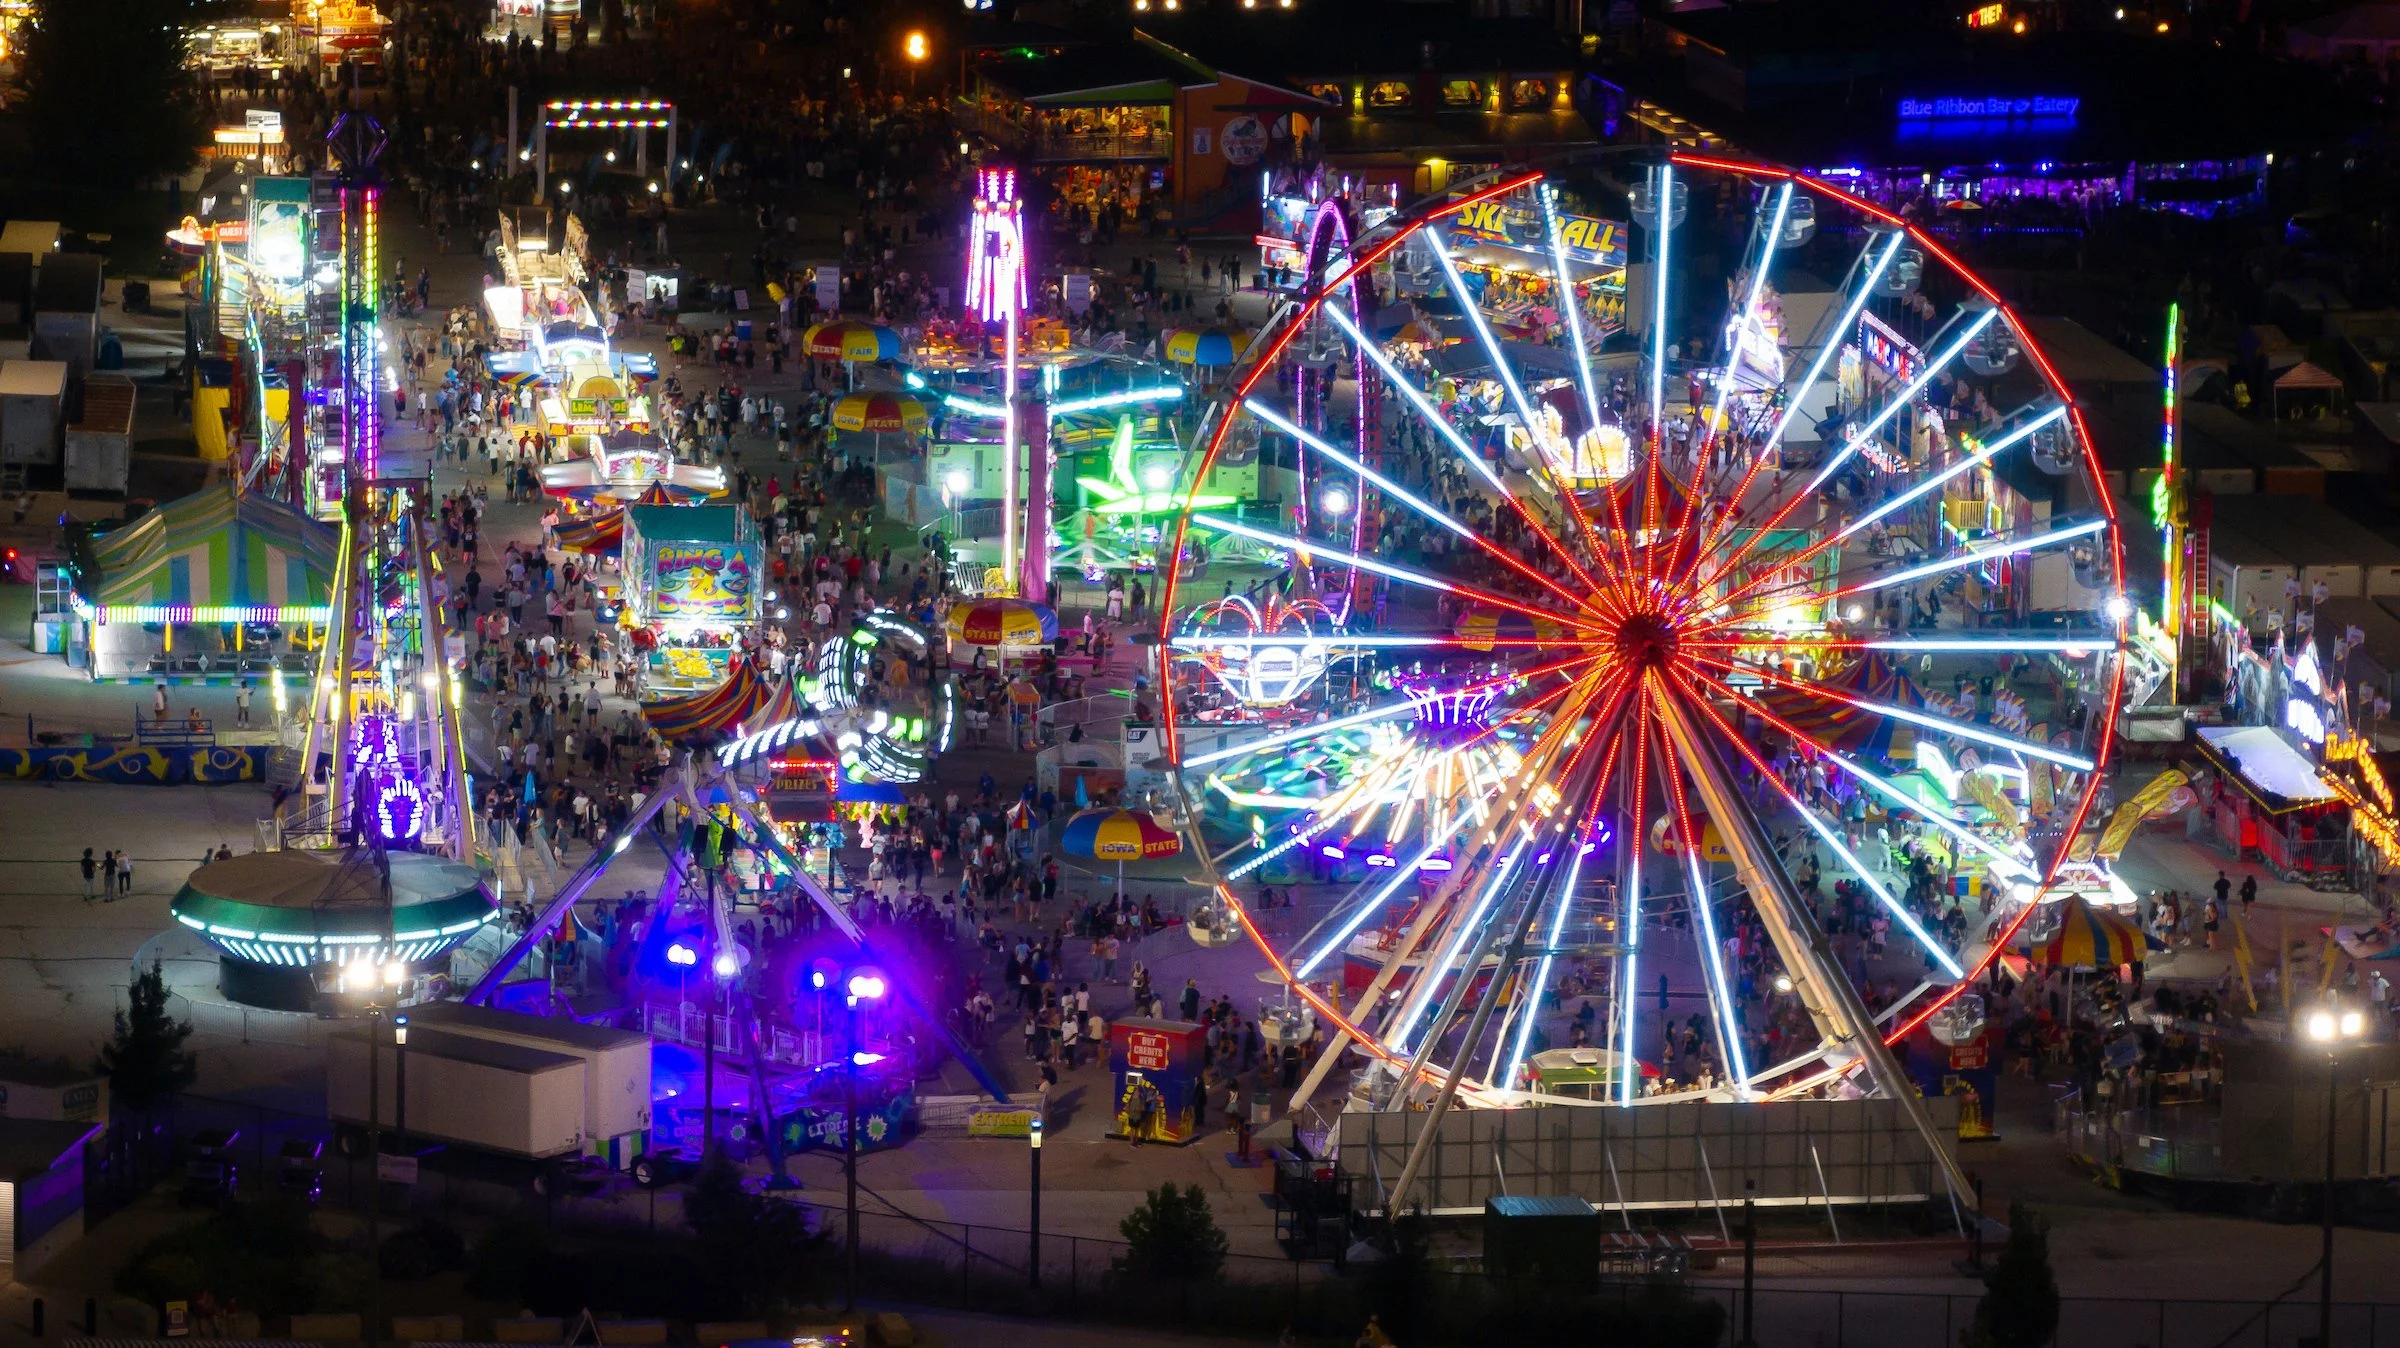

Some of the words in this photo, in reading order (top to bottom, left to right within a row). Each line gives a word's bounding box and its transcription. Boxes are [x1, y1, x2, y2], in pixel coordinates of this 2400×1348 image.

[1902, 99, 1932, 116] Blue
[1936, 97, 1985, 115] Ribbon
[1987, 97, 2012, 113] Bar
[2014, 98, 2031, 113] &
[2034, 95, 2079, 115] Eatery
[572, 401, 627, 415] LEMDE
[838, 415, 860, 426] IOWA
[866, 419, 902, 428] STATE
[656, 547, 725, 576] RING
[728, 549, 751, 577] A
[1746, 563, 1816, 587] WIN
[656, 591, 748, 617] DUCK
[964, 628, 1000, 641] STATE
[1010, 629, 1036, 640] FAIR
[1101, 843, 1136, 853] IOWA
[1144, 839, 1178, 854] STATE
[1141, 1036, 1157, 1046] BUY
[1133, 1046, 1164, 1057] CREDITS
[1138, 1056, 1158, 1066] HERE
